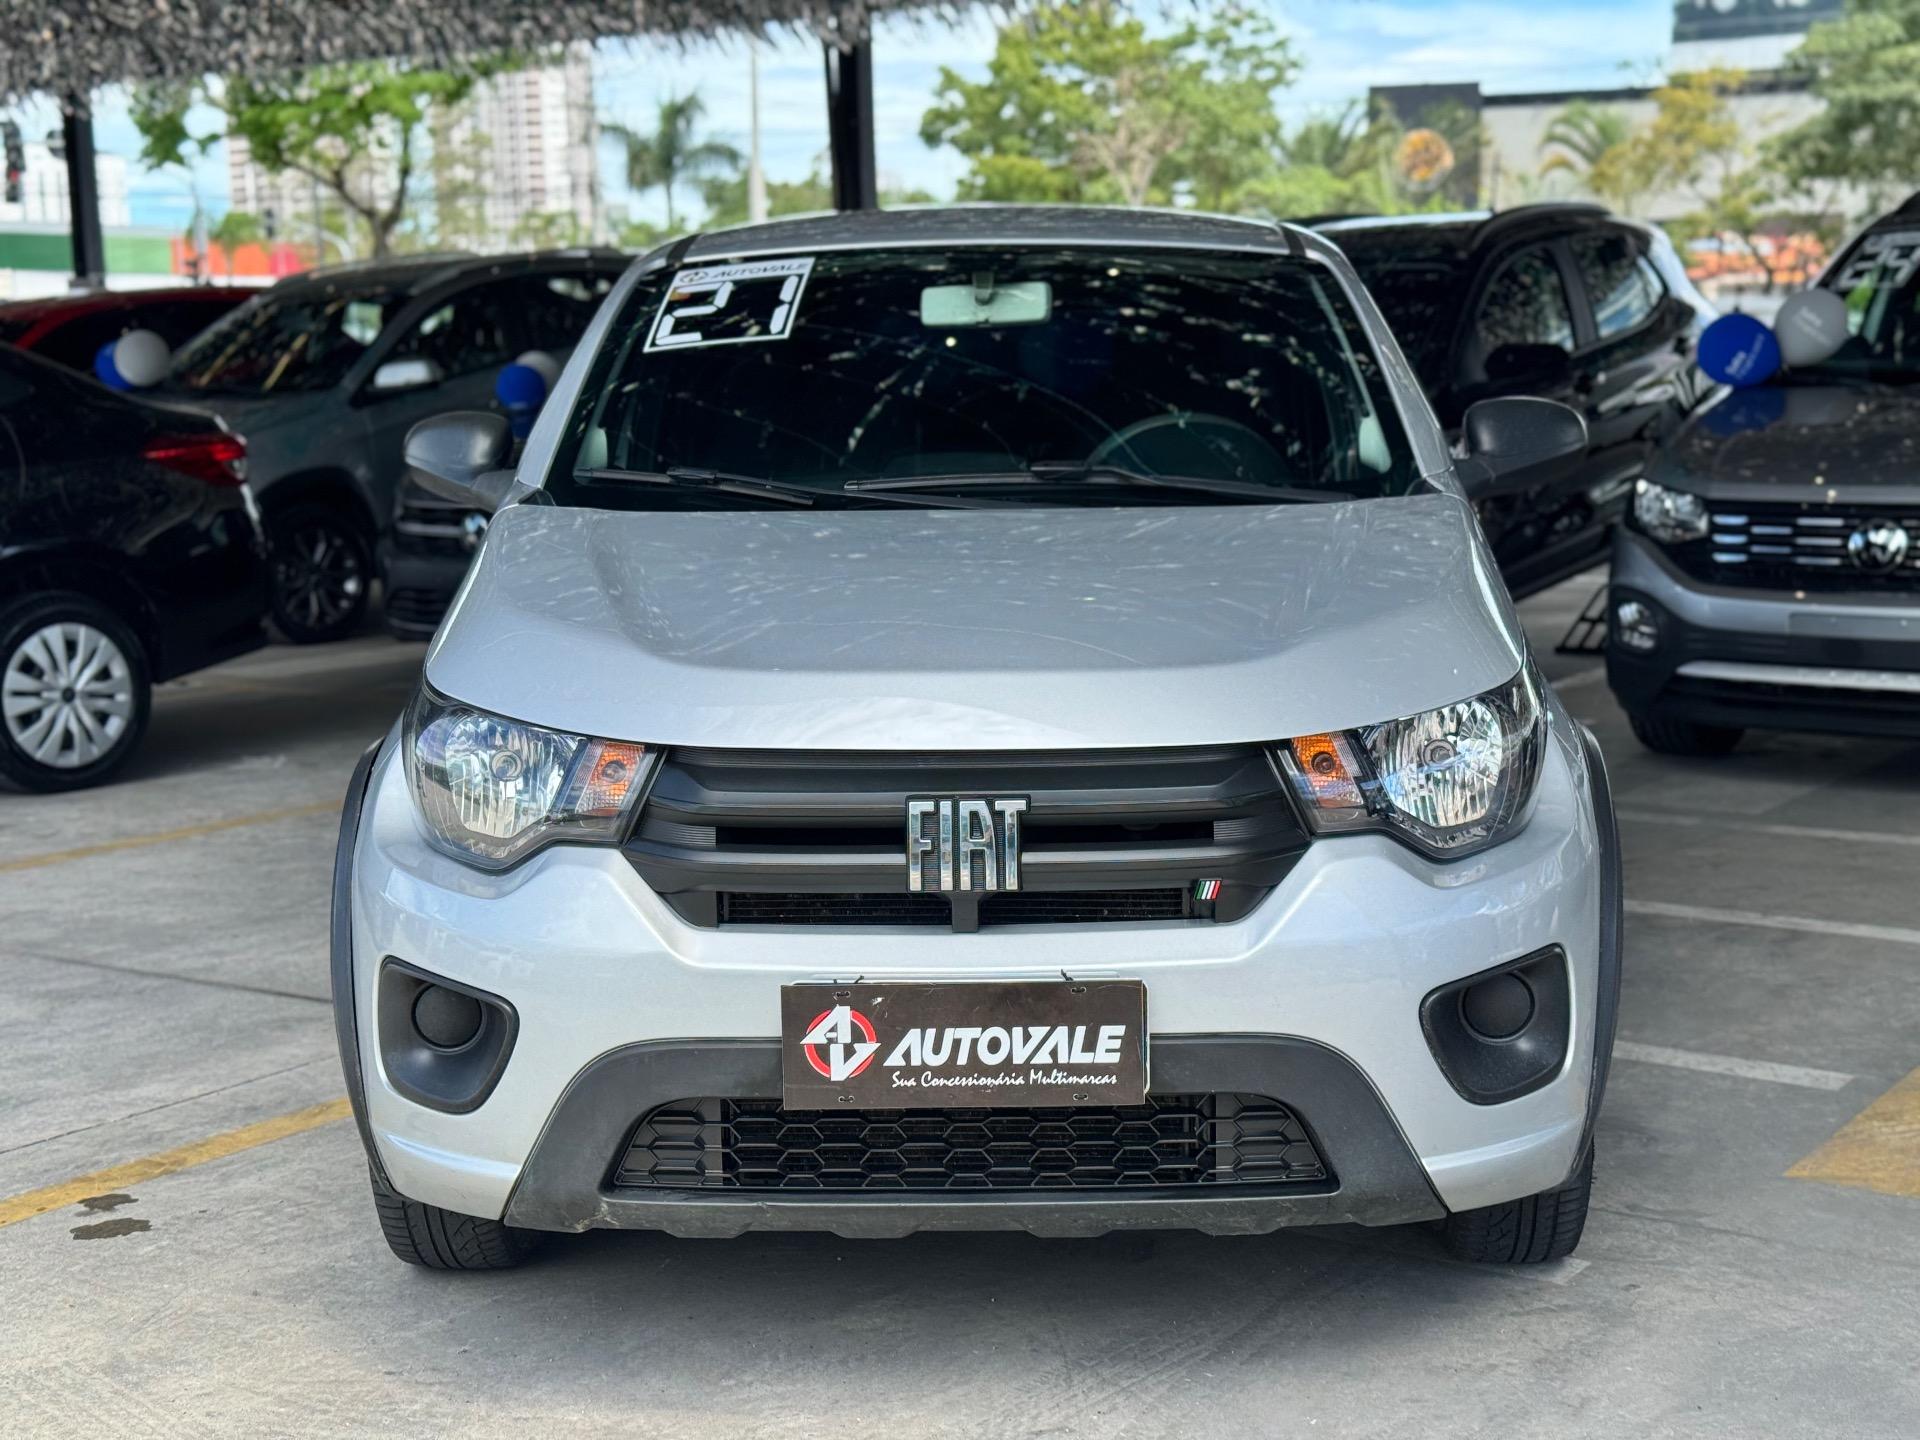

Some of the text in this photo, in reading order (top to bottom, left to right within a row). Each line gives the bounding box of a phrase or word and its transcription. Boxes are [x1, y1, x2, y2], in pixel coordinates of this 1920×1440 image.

[711, 262, 807, 278] AUTOVALE
[655, 275, 799, 346] 21
[908, 799, 1027, 891] FIAT
[882, 1024, 1126, 1067] AUTOVALE
[892, 1068, 1118, 1088] Sua Concessionária Multimarcas
